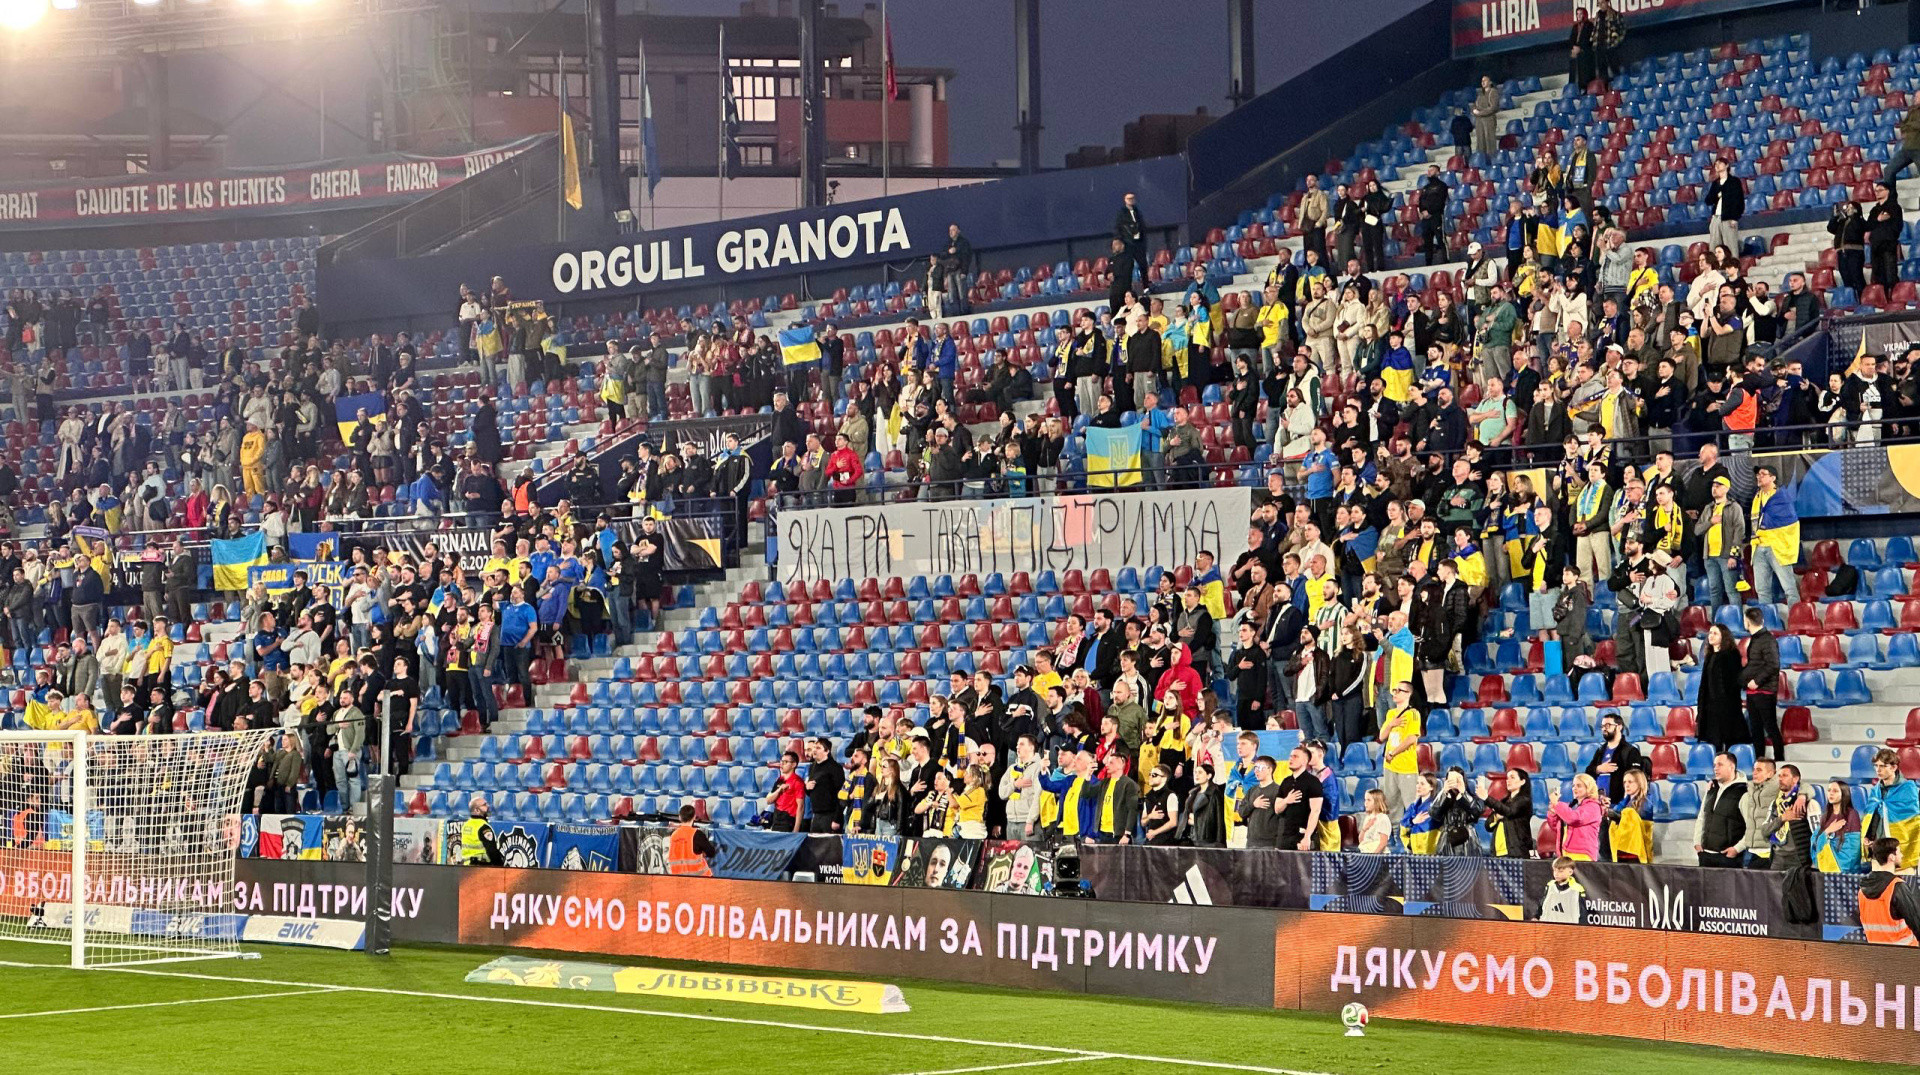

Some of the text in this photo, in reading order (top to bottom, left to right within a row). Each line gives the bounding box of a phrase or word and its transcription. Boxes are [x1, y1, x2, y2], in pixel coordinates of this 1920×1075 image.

[1481, 0, 1540, 38] LLIRIA
[310, 169, 361, 200] CHERA
[386, 161, 438, 193] FAVARA
[76, 176, 285, 216] CAUDETE DE LAS FUENTES
[553, 207, 911, 293] ORGULL GRANOTA
[430, 531, 488, 553] TRNAVA
[786, 513, 837, 586] ЯКА
[845, 511, 892, 579] ГРА
[922, 501, 984, 575] ТАКА
[819, 863, 843, 875] УКРАЇН
[14, 870, 224, 908] ВБОЛВАЛЬНИКАМ
[234, 881, 264, 911] ЗА
[273, 883, 424, 920] ПІДТРИКУ
[1585, 898, 1636, 914] РАЇНСЬКА
[1587, 914, 1636, 928] СОЦІАЦІЯ
[1698, 906, 1757, 921] UKRAINIAN
[1698, 920, 1768, 936] ASSOCIATION
[277, 920, 319, 941] awt
[490, 891, 1218, 975] ДЯКУЄМО ВБОЛІВАЛЬНИКАМ ЗА ПІДТРИМКУ
[1330, 945, 1555, 999] ДЯКУЄМО
[637, 972, 861, 1006] ЛЬВІВСЬКЕ
